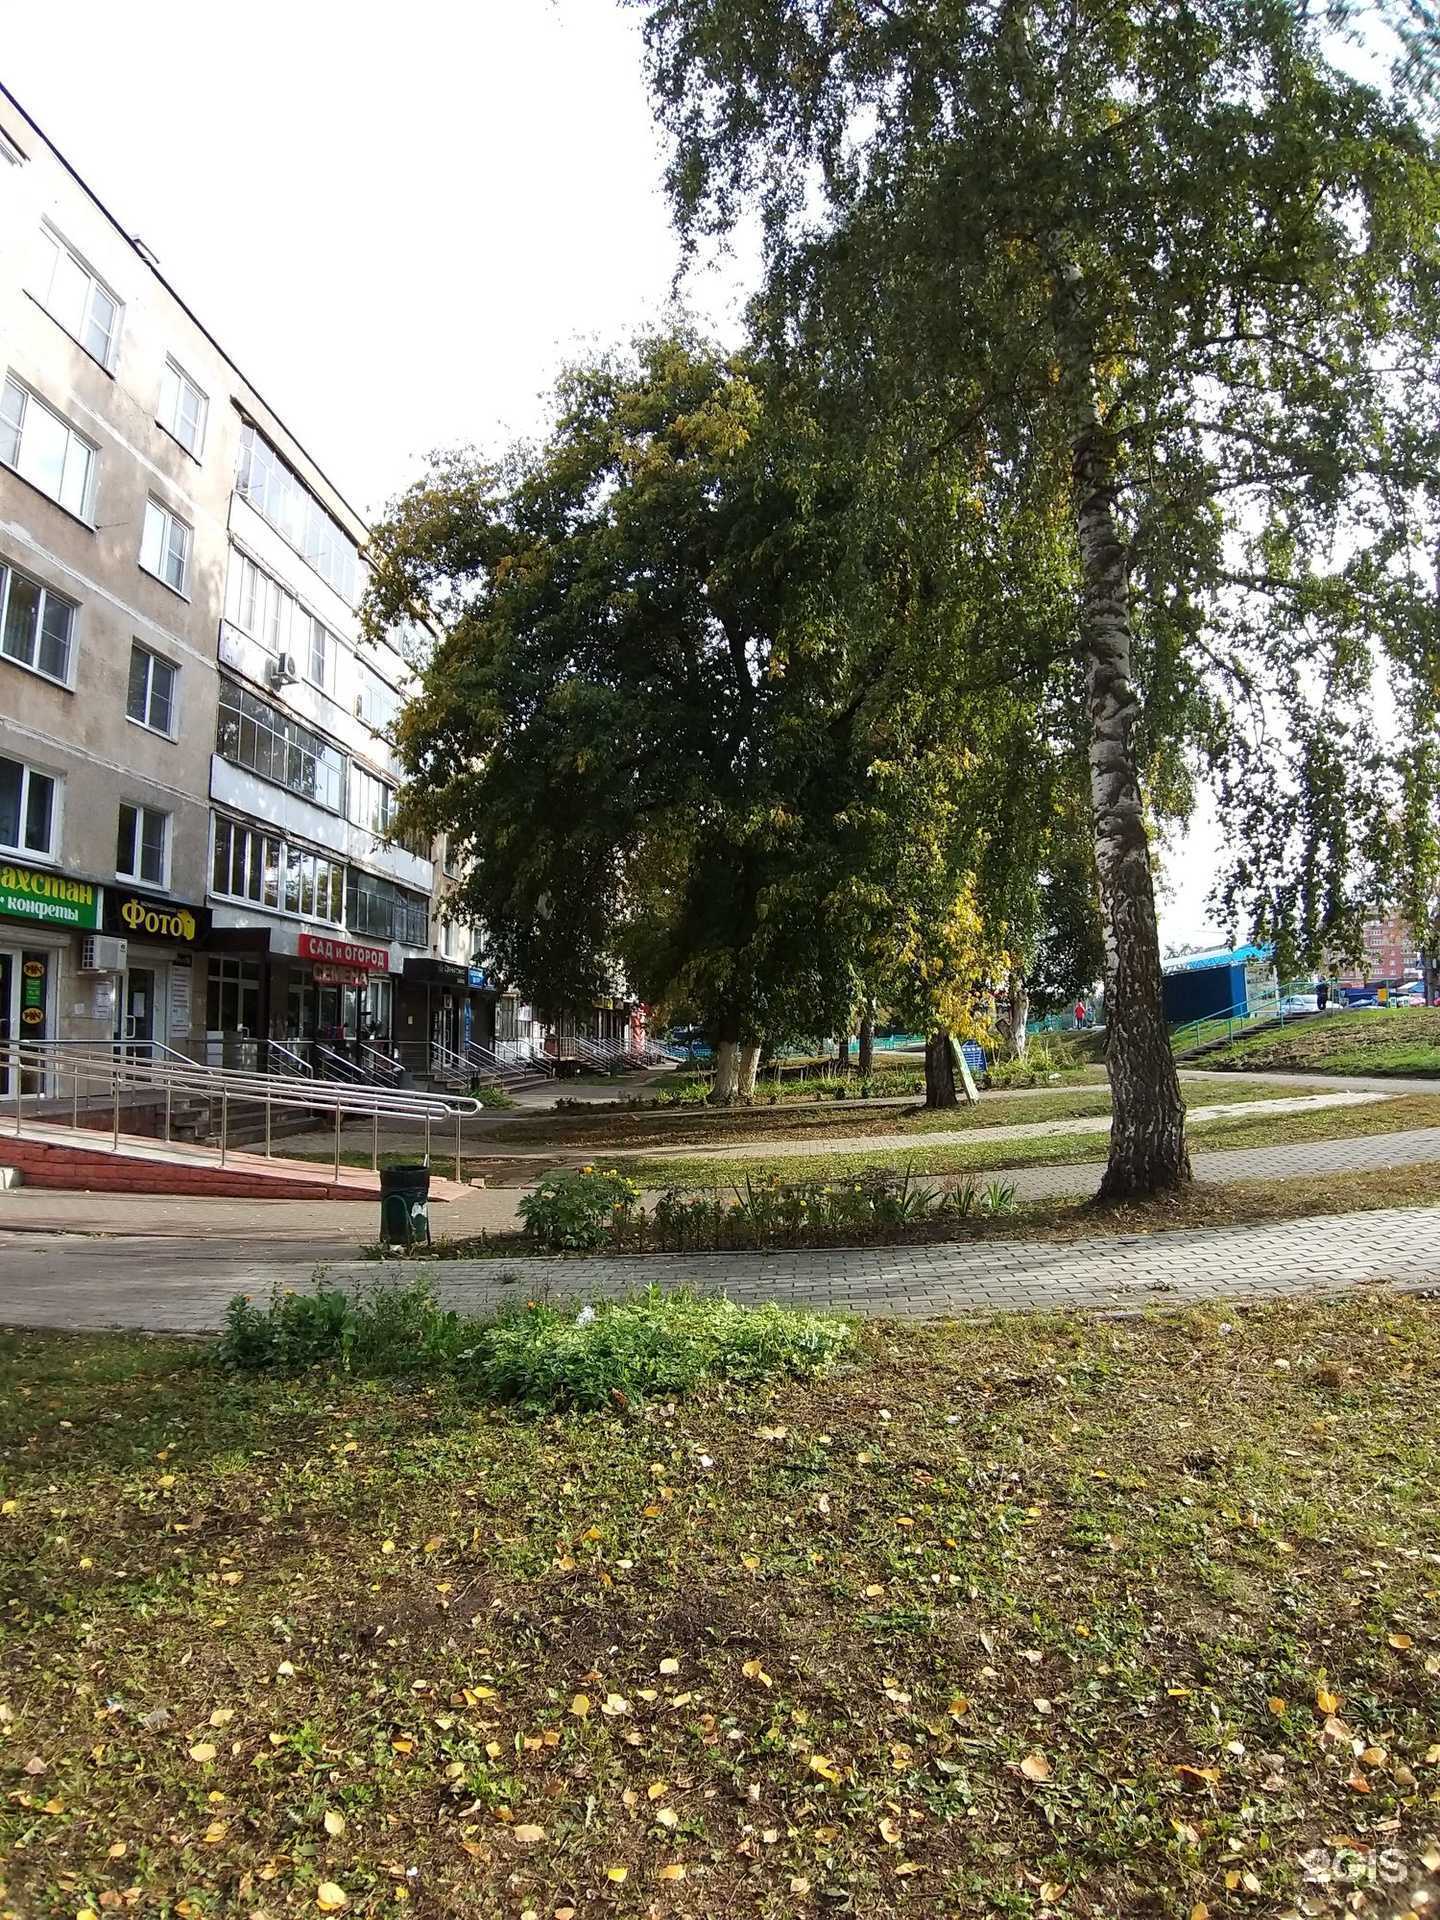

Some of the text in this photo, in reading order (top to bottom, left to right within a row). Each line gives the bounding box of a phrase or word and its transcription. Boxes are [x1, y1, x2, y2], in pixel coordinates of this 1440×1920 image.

[7, 896, 79, 921] конфеты
[309, 938, 333, 960] САД
[345, 945, 384, 969] ОГОРОД
